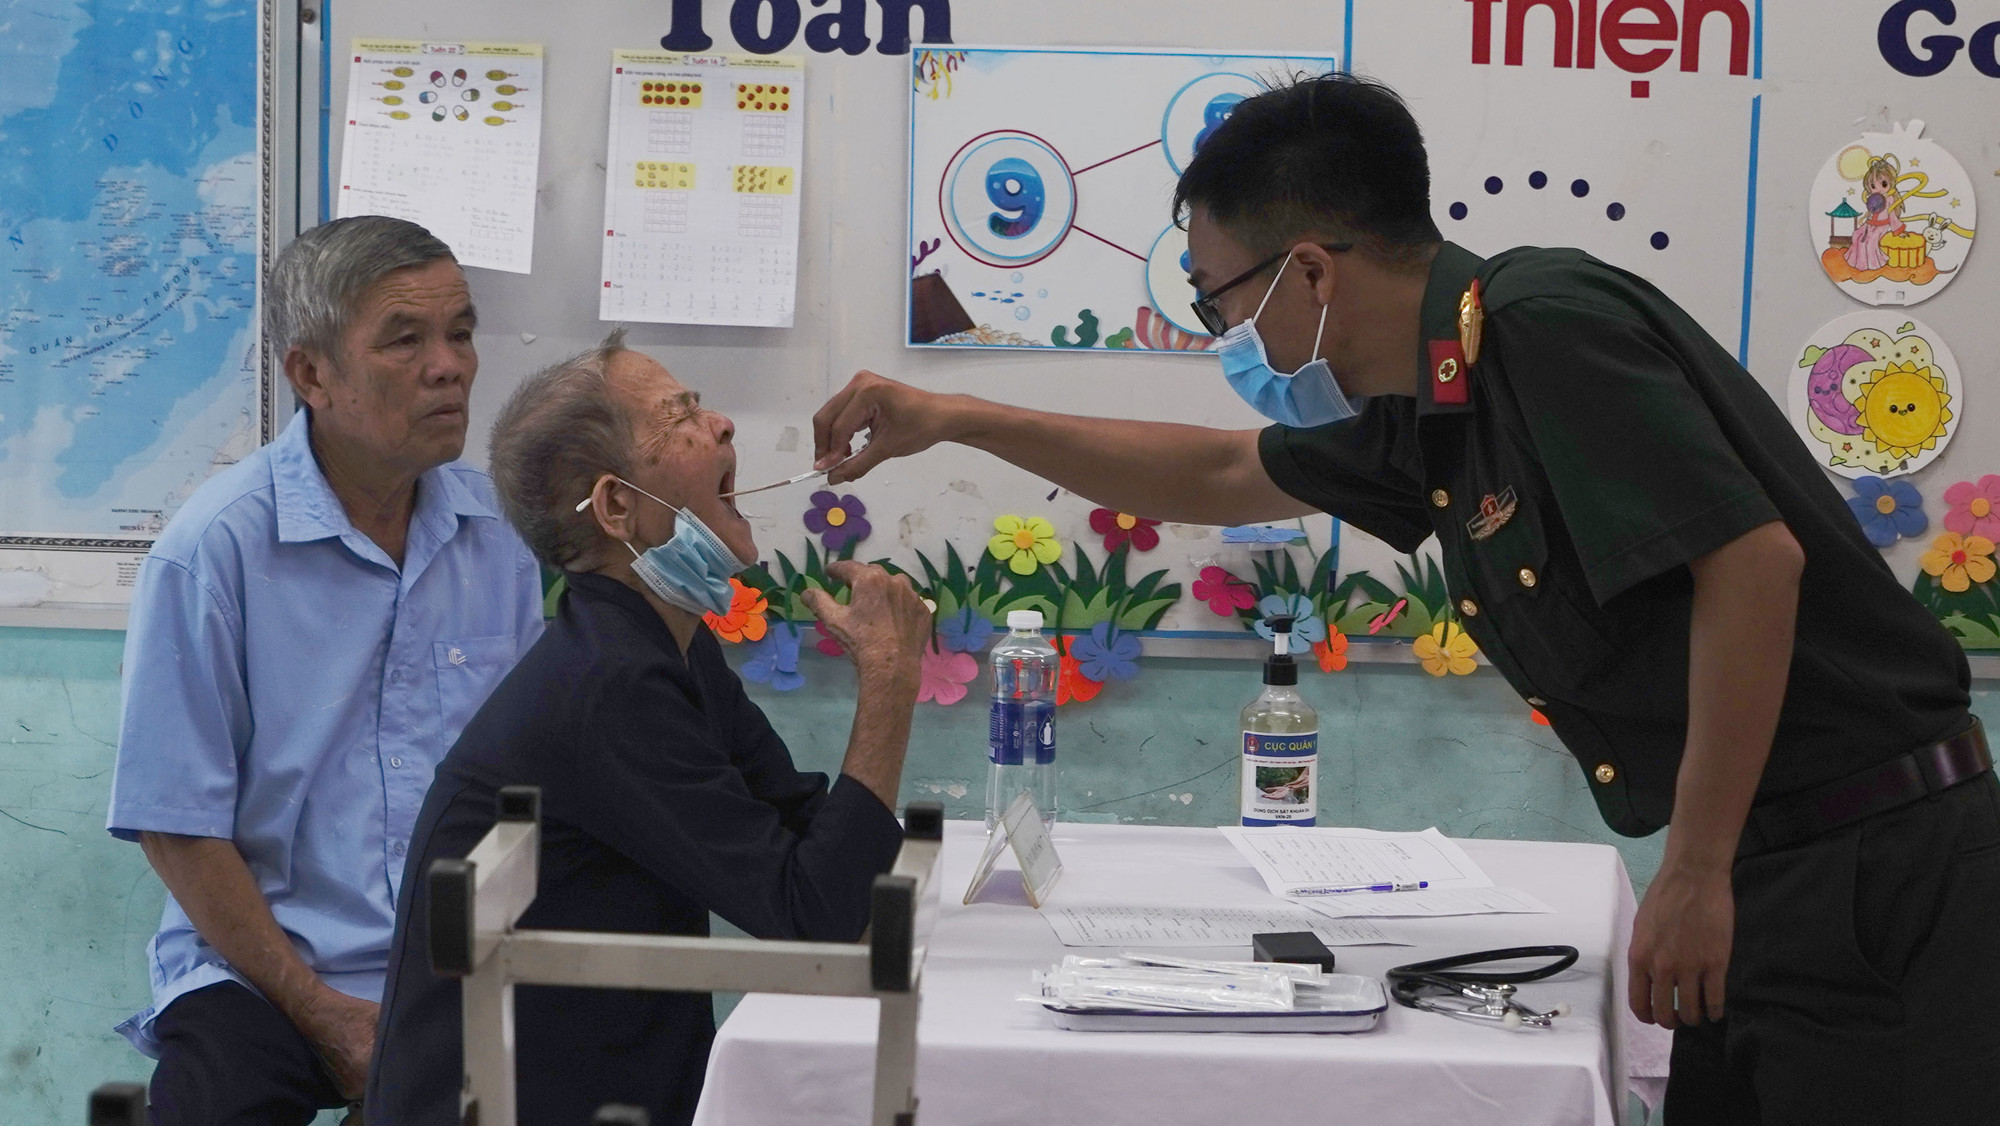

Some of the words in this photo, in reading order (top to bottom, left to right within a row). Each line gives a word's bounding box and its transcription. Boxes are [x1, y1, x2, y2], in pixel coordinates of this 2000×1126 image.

[985, 157, 1046, 240] 9
[1264, 742, 1286, 752] CỤC
[1288, 740, 1313, 751] QUÂN
